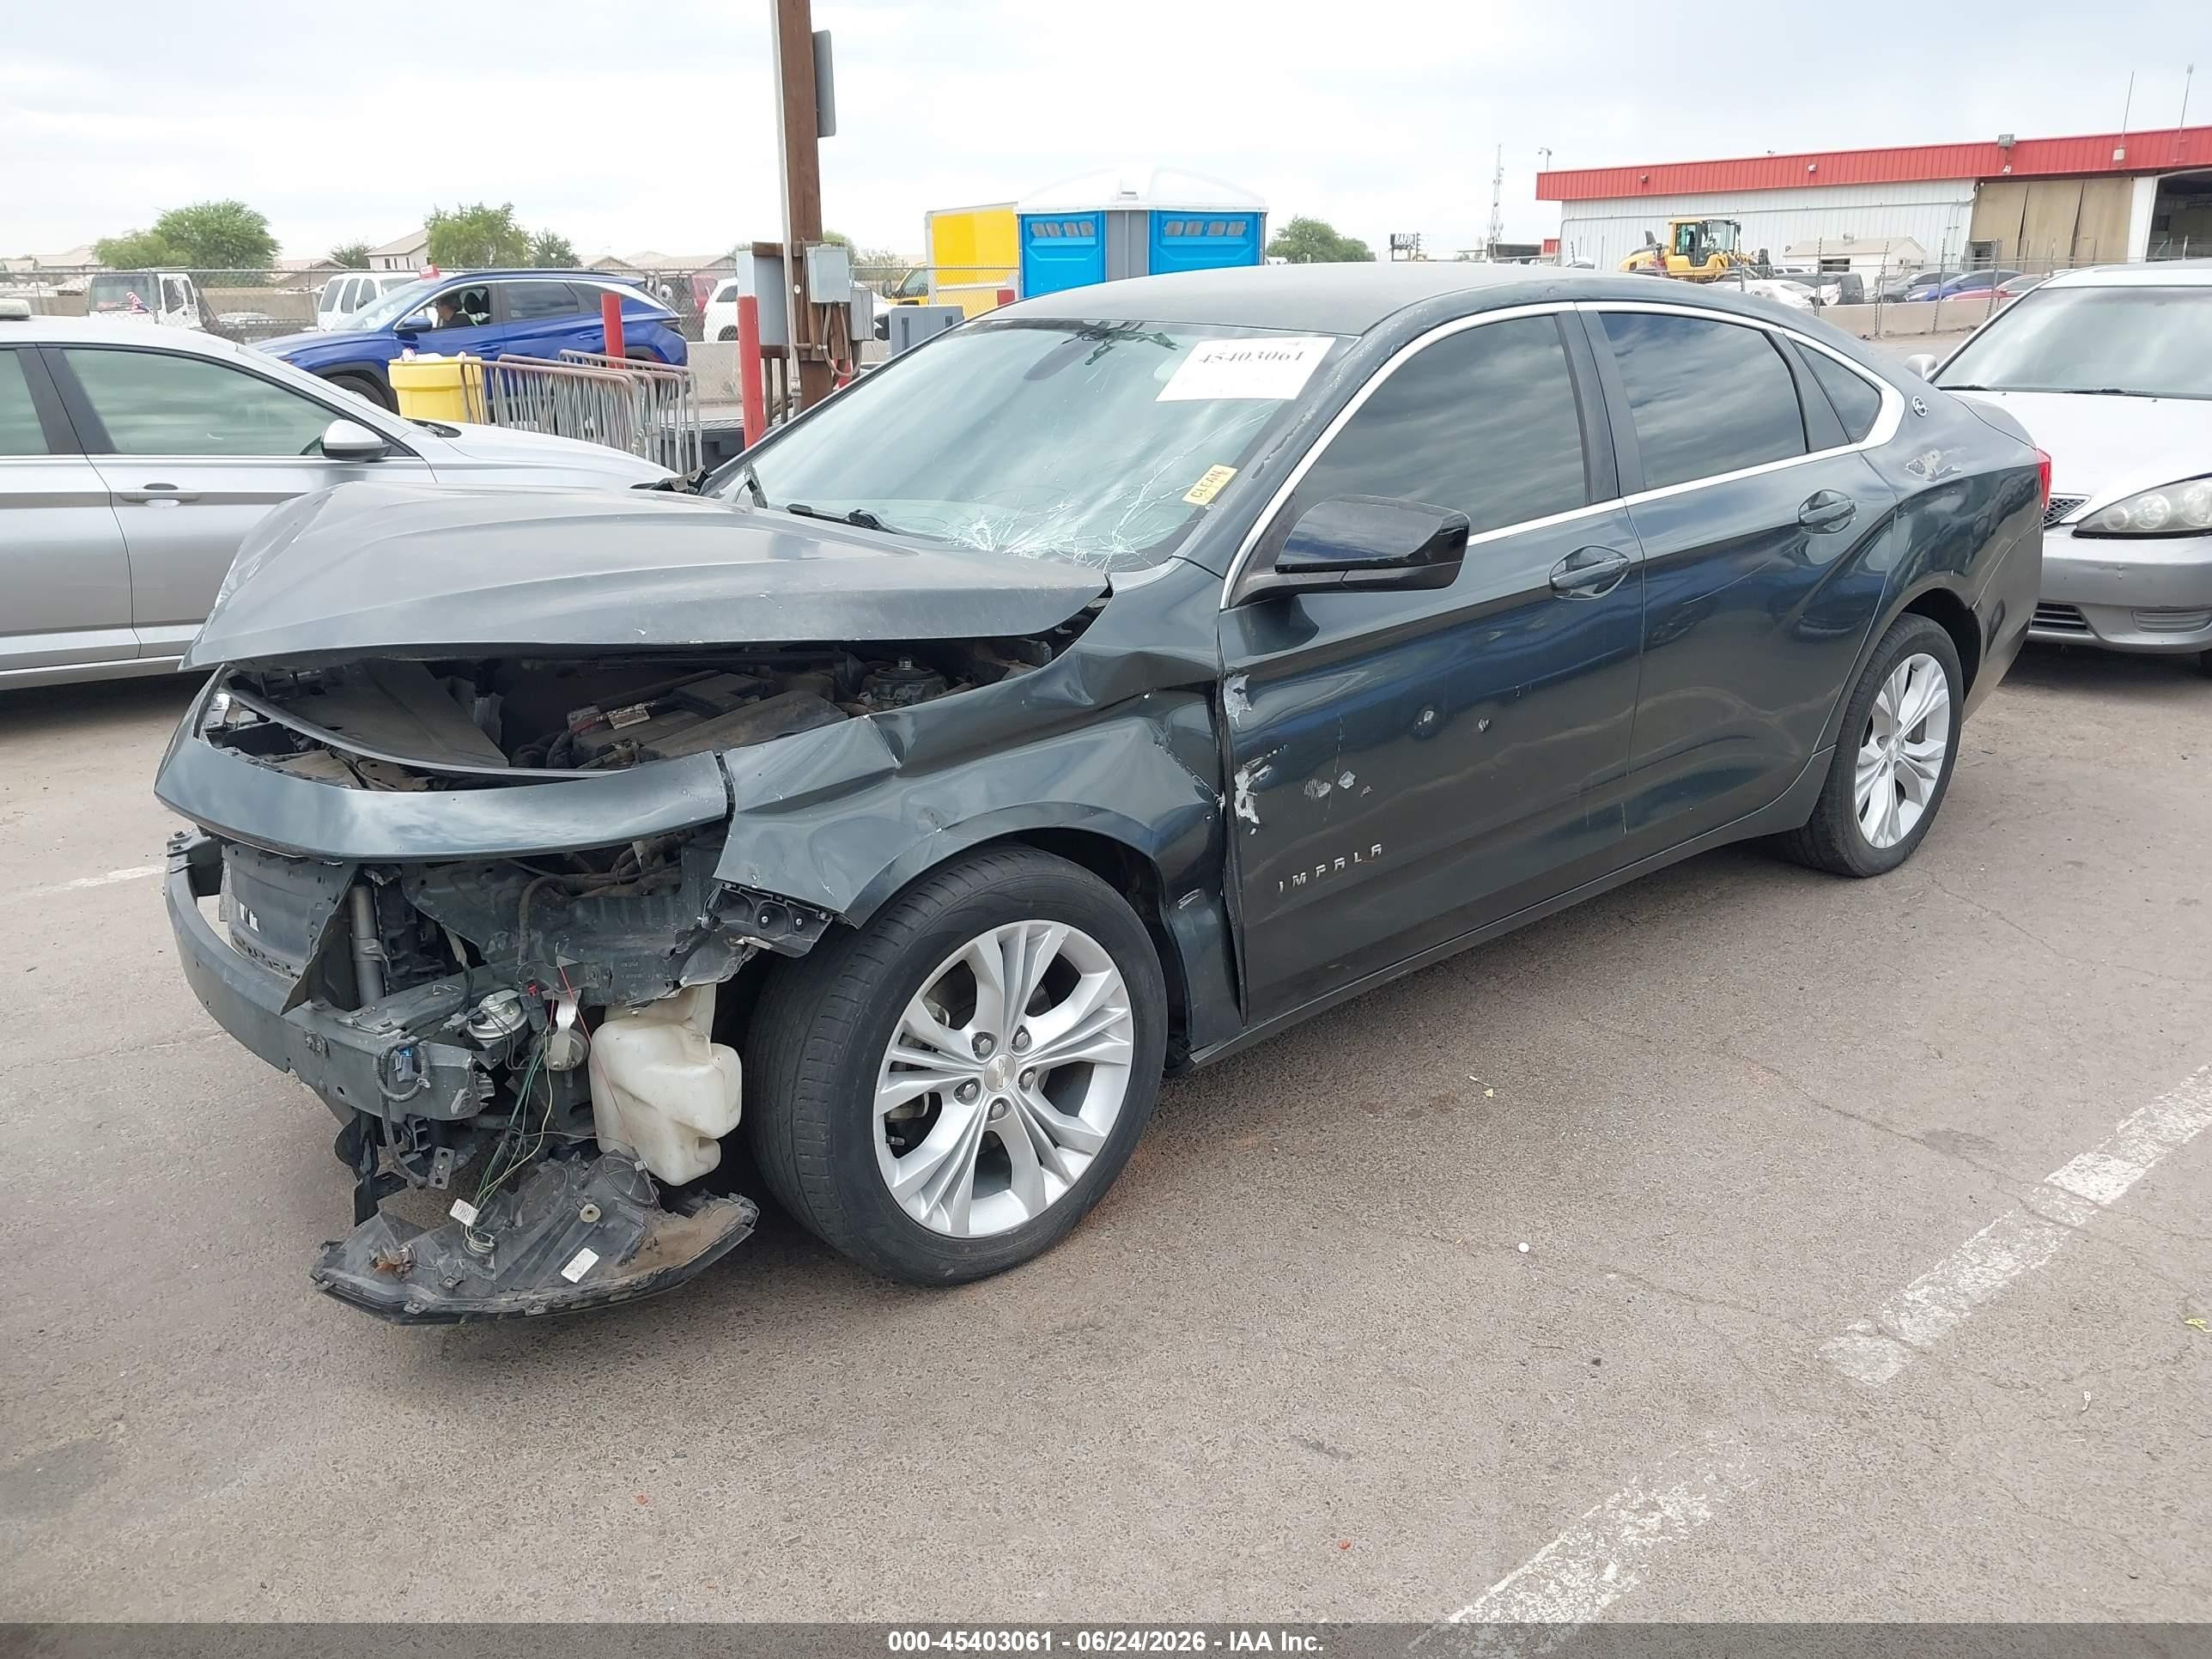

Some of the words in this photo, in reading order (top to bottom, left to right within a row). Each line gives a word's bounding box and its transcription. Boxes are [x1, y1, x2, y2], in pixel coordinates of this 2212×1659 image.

[1197, 349, 1305, 364] 45403061
[1190, 470, 1222, 498] CLEAN
[1278, 842, 1382, 894] IMPALA
